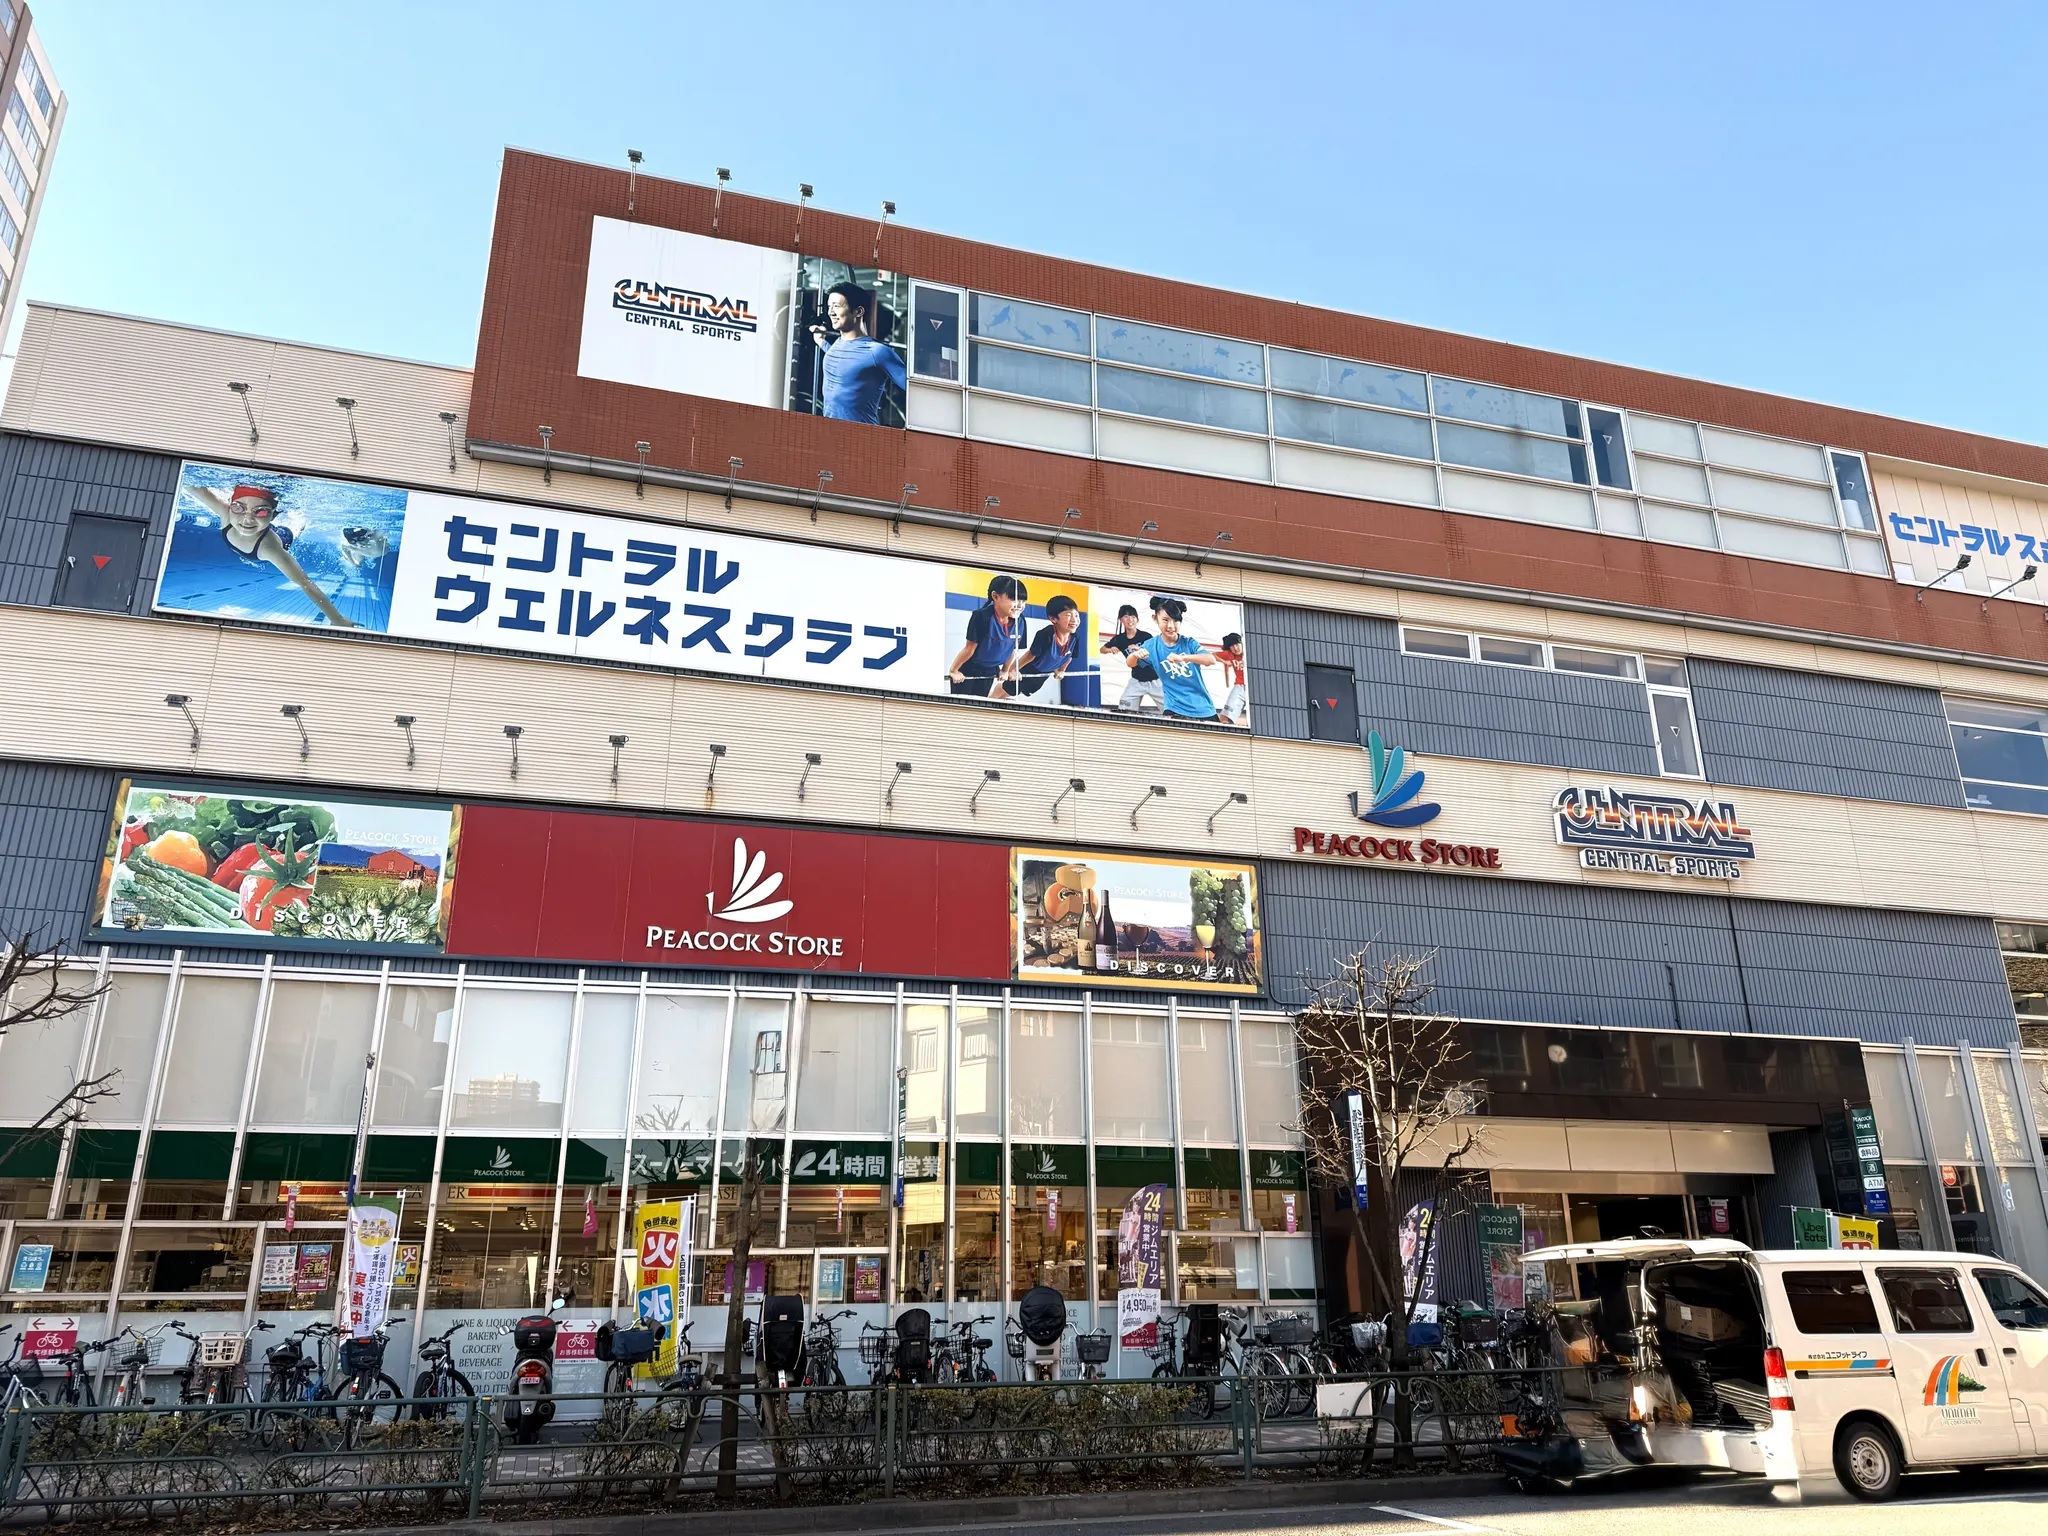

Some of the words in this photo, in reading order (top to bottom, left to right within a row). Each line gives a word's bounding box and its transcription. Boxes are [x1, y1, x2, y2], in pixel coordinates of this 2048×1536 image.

[625, 311, 684, 332] CENTRAL
[691, 323, 742, 342] SPORTS
[443, 515, 740, 595] セントラル
[344, 829, 399, 843] PEACOCK
[402, 831, 439, 845] STORE
[1293, 826, 1415, 863] PEACOCK
[1420, 838, 1503, 869] STORE
[1584, 848, 1668, 874] CENTRAL
[1675, 857, 1742, 881] SPORTS
[230, 906, 410, 930] DISCOVER
[645, 925, 763, 953] PEACOCK
[768, 931, 844, 956] STORE
[1109, 959, 1235, 977] DISCOVER
[1860, 1148, 1879, 1157] 食料品
[473, 1169, 504, 1177] PEACOCK
[504, 1169, 525, 1177] STORE
[1026, 1172, 1050, 1180] PEACOCK
[1256, 1177, 1279, 1185] PEACOCK
[1868, 1179, 1884, 1188] ATM
[1802, 1221, 1825, 1232] Uber
[1804, 1232, 1828, 1242] Eats
[1841, 1229, 1875, 1241] 毎週恒例
[1149, 1224, 1160, 1284] ジムエリア
[452, 1319, 475, 1328] WINE
[476, 1319, 484, 1328] &
[467, 1331, 500, 1341] BAKERY
[462, 1344, 502, 1354] GROCERY
[458, 1357, 503, 1368] BEVERAGE
